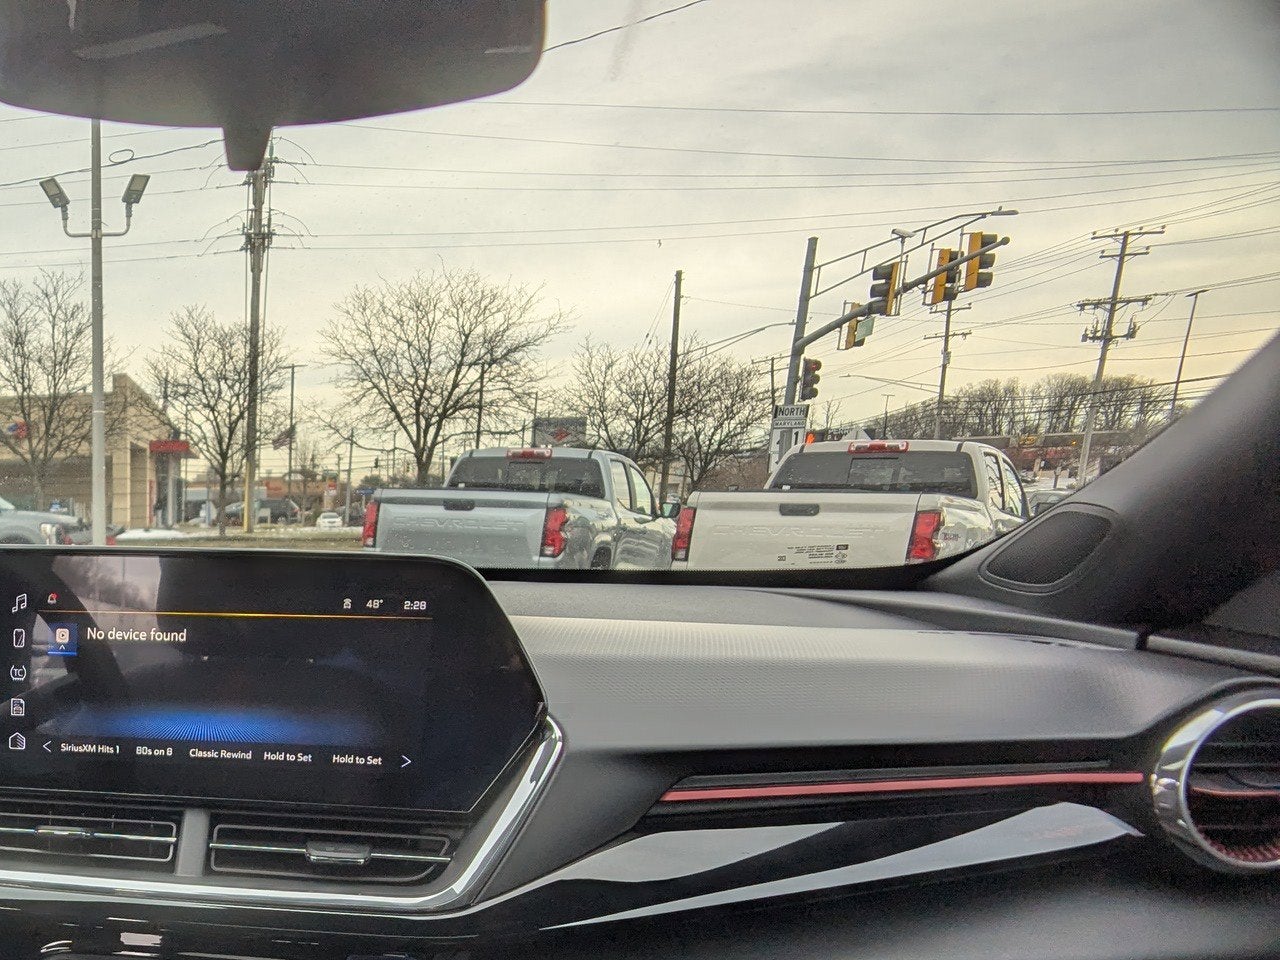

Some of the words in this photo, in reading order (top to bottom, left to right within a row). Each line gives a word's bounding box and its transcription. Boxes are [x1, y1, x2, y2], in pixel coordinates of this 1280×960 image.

[778, 406, 805, 417] NORTH
[87, 627, 105, 641] No
[107, 628, 147, 641] device
[150, 628, 187, 642] found
[60, 743, 96, 753] SiriusXM
[97, 744, 114, 754] Hits
[153, 748, 165, 756] on
[189, 748, 219, 758] Classic
[220, 749, 252, 760] Rewind
[263, 751, 285, 761] Hold
[286, 752, 296, 762] to
[297, 752, 313, 763] Set
[332, 754, 354, 764] Hold
[355, 755, 365, 765] to
[366, 755, 383, 766] Set
